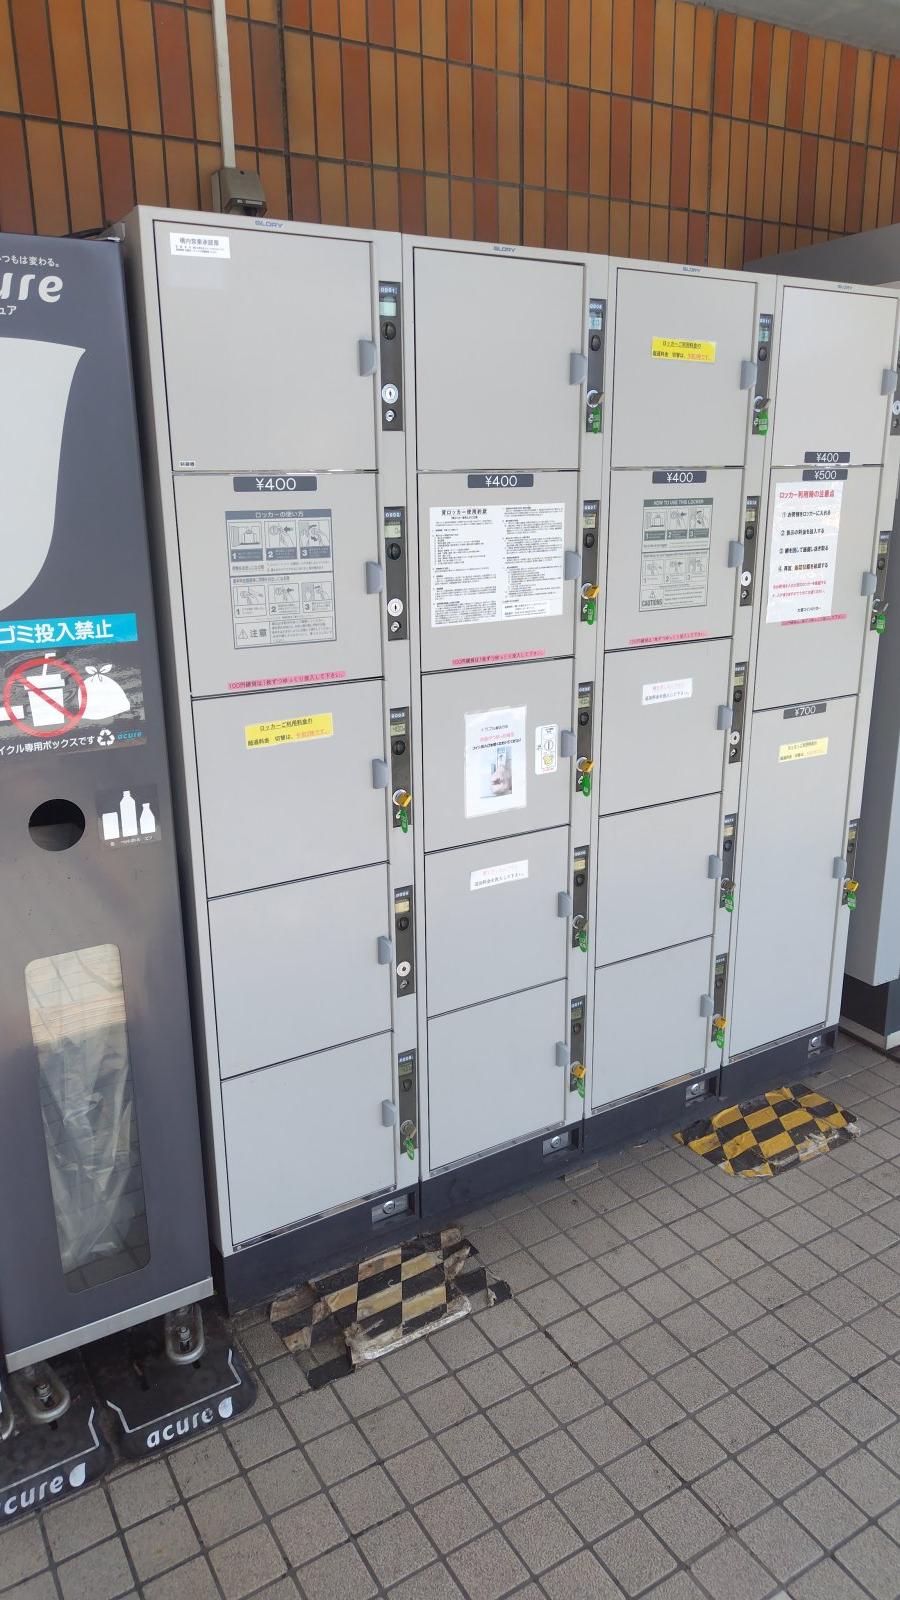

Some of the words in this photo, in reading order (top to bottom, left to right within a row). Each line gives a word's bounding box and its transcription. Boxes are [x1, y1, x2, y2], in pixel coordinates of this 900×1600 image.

[255, 220, 284, 228] GLORY
[0, 254, 59, 268] つもは変わる。
[816, 452, 839, 463] ¥400
[666, 472, 694, 483] ¥400
[814, 470, 837, 480] ¥500
[255, 477, 297, 491] ¥400
[485, 475, 518, 488] ¥400
[256, 511, 304, 519] ロッカーの使い方
[0, 619, 114, 644] ゴミ投入禁止
[249, 628, 267, 638] 注意
[795, 705, 817, 716] ¥700
[146, 1407, 214, 1448] acure
[0, 1475, 64, 1515] cure
